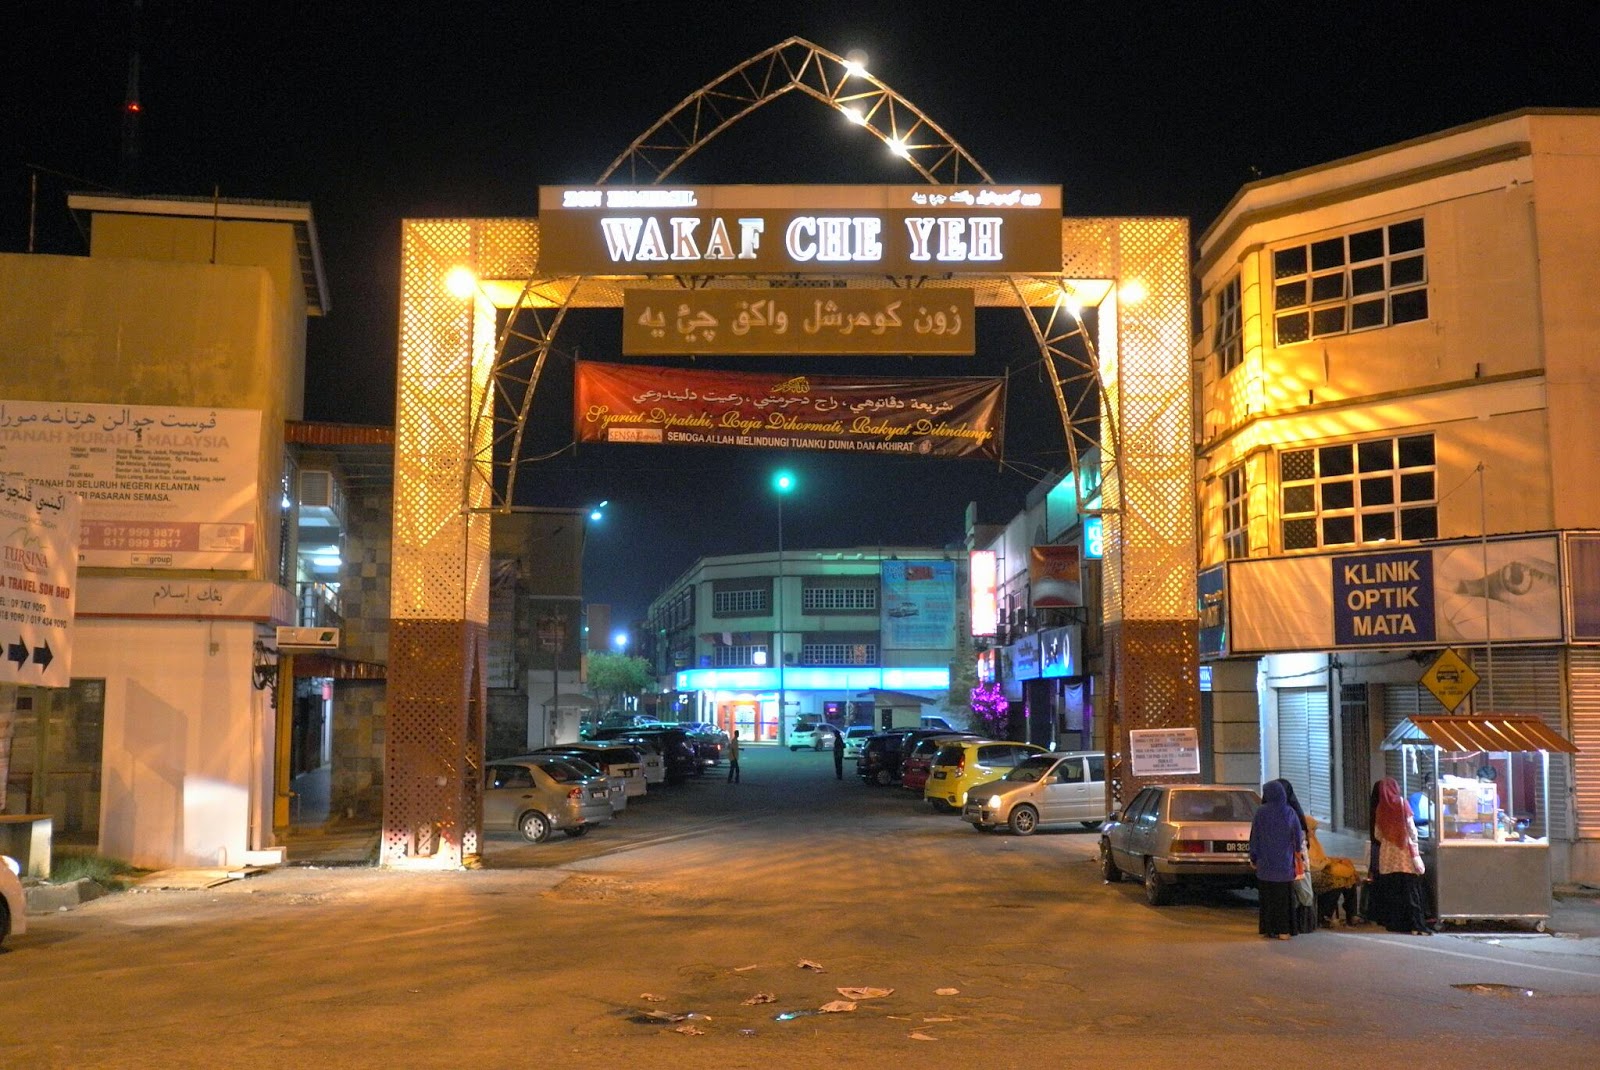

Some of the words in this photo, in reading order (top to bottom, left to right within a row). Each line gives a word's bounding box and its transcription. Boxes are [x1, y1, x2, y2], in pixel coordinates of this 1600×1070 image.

[601, 216, 764, 262] WAKAF
[785, 216, 883, 262] CHE
[904, 216, 1004, 261] YEH
[914, 304, 962, 335] زون
[718, 410, 762, 435] Raja
[849, 415, 913, 441] Rakyat
[912, 418, 995, 446] Dilindungi
[147, 433, 230, 449] MALAYSIA
[667, 431, 705, 443] SEMOGA
[706, 433, 735, 445] ALLAH
[736, 435, 790, 448] MELINDUNGI
[791, 438, 828, 450] TUANKU
[828, 440, 855, 451] DUNIA
[857, 441, 876, 452] DAN
[876, 442, 915, 453] AKHIRAT
[23, 478, 64, 488] RTANAH
[65, 479, 75, 488] DI
[76, 480, 118, 490] SELURUH
[120, 481, 152, 490] NEGERI
[154, 482, 200, 492] KELANTAN
[89, 491, 131, 501] PASARAN
[104, 528, 125, 537] 017
[128, 528, 150, 537] 999
[152, 529, 181, 538] 9871
[128, 539, 150, 547] 999
[3, 545, 48, 571] TURSINA
[149, 556, 172, 564] group
[1344, 559, 1421, 586] KLINIK
[8, 576, 37, 594] TRAVEL
[56, 585, 70, 600] BHD
[1347, 586, 1419, 612] OPTIK
[10, 598, 19, 608] 09
[1353, 612, 1417, 637] MATA
